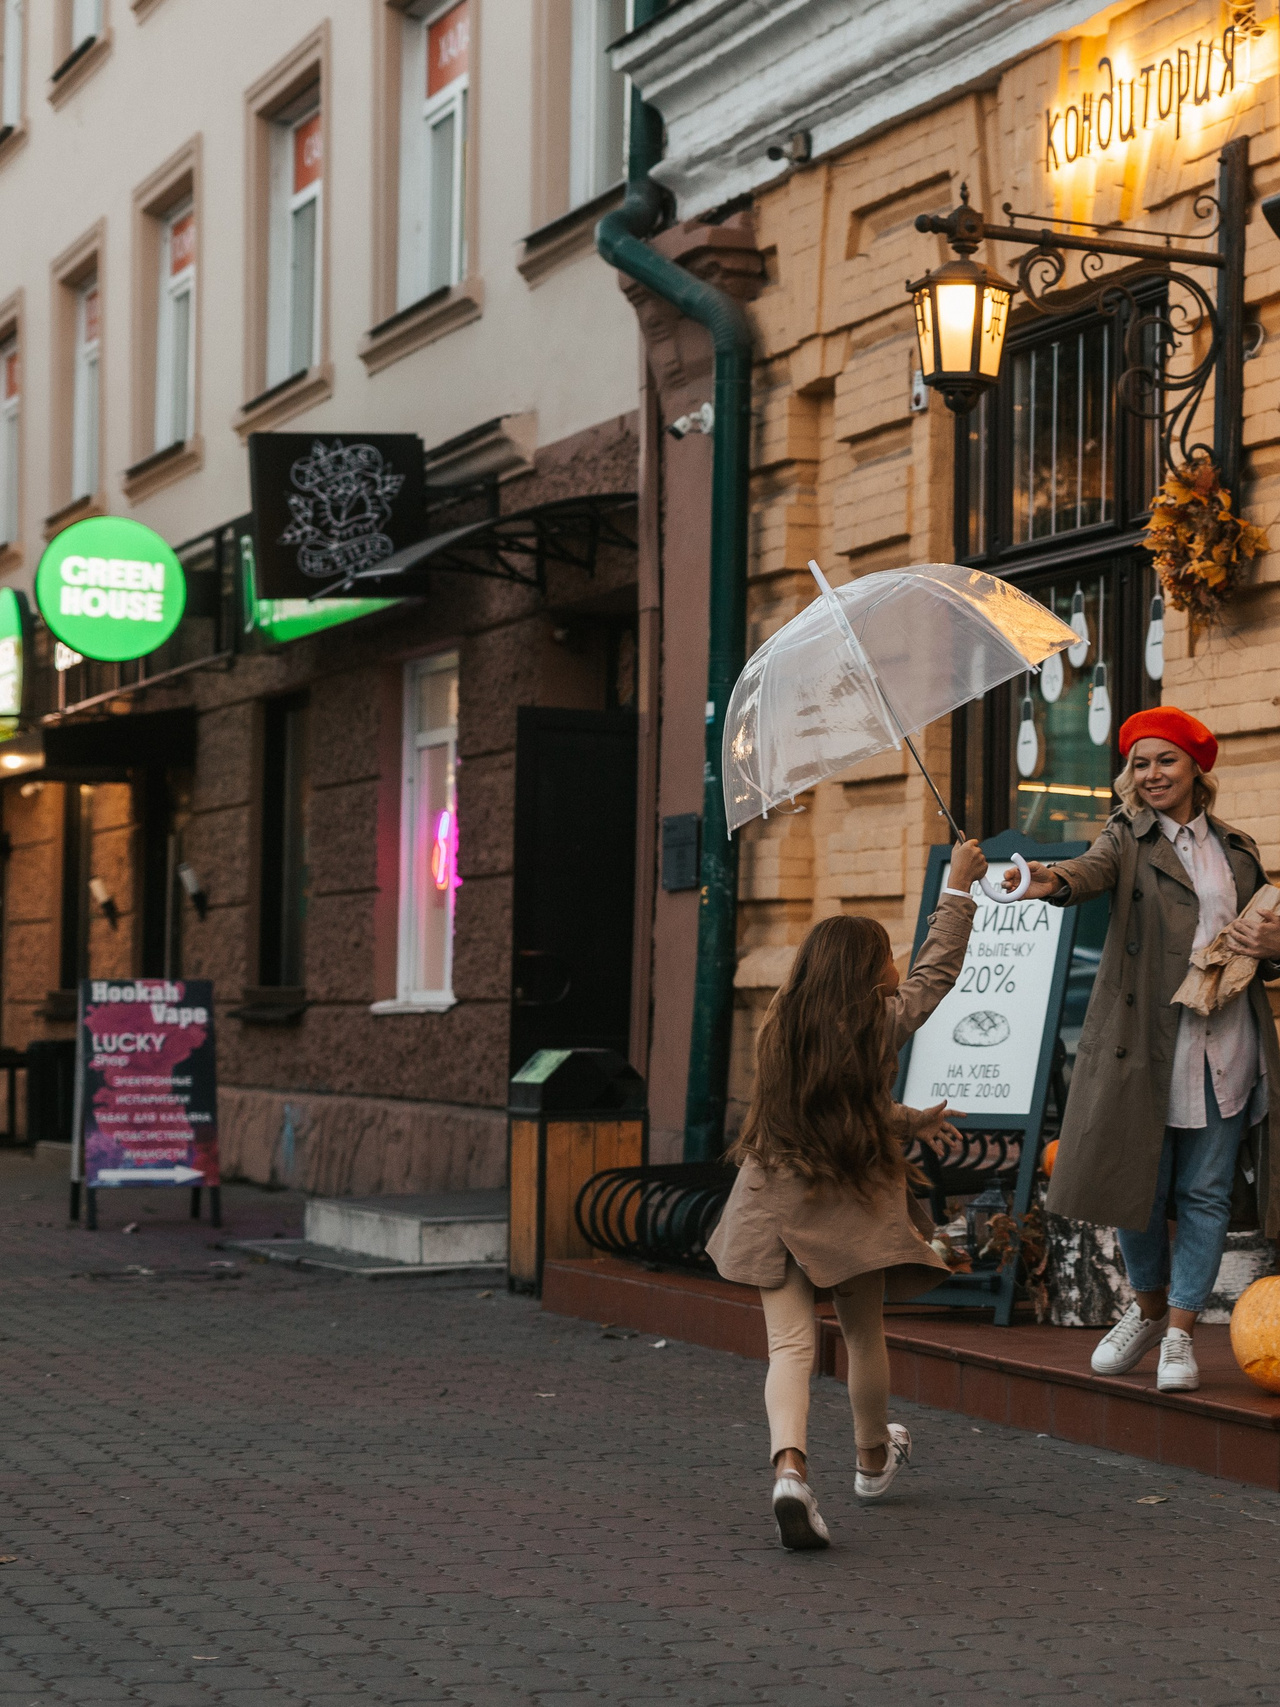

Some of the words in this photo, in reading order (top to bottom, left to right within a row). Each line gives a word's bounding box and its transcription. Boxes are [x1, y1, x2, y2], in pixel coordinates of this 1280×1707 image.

[60, 555, 165, 592] GREEN
[60, 585, 164, 622] HOUSE
[973, 903, 1049, 935] ИДКА
[977, 942, 1036, 958] ВЫПЕЧКУ
[960, 963, 1016, 993] 20%
[91, 980, 180, 1002] Hookah
[150, 1003, 208, 1029] Vape
[92, 1032, 166, 1052] LUCKY
[93, 1054, 130, 1067] Shop
[947, 1064, 963, 1078] НА
[968, 1063, 1001, 1079] ХЛЕБ
[113, 1075, 192, 1087] ЭЛЕКТРОННЫЕ
[931, 1082, 972, 1098] ПОСЛЕ
[975, 1083, 1011, 1098] 20:00
[116, 1094, 191, 1105] ИСПАРИТЕЛИ
[94, 1111, 129, 1123] ТАБАК
[133, 1111, 157, 1123] ДЛЯ
[160, 1112, 212, 1123] КАЛЬЯНА
[123, 1149, 188, 1160] ЖИДКОСТИ
